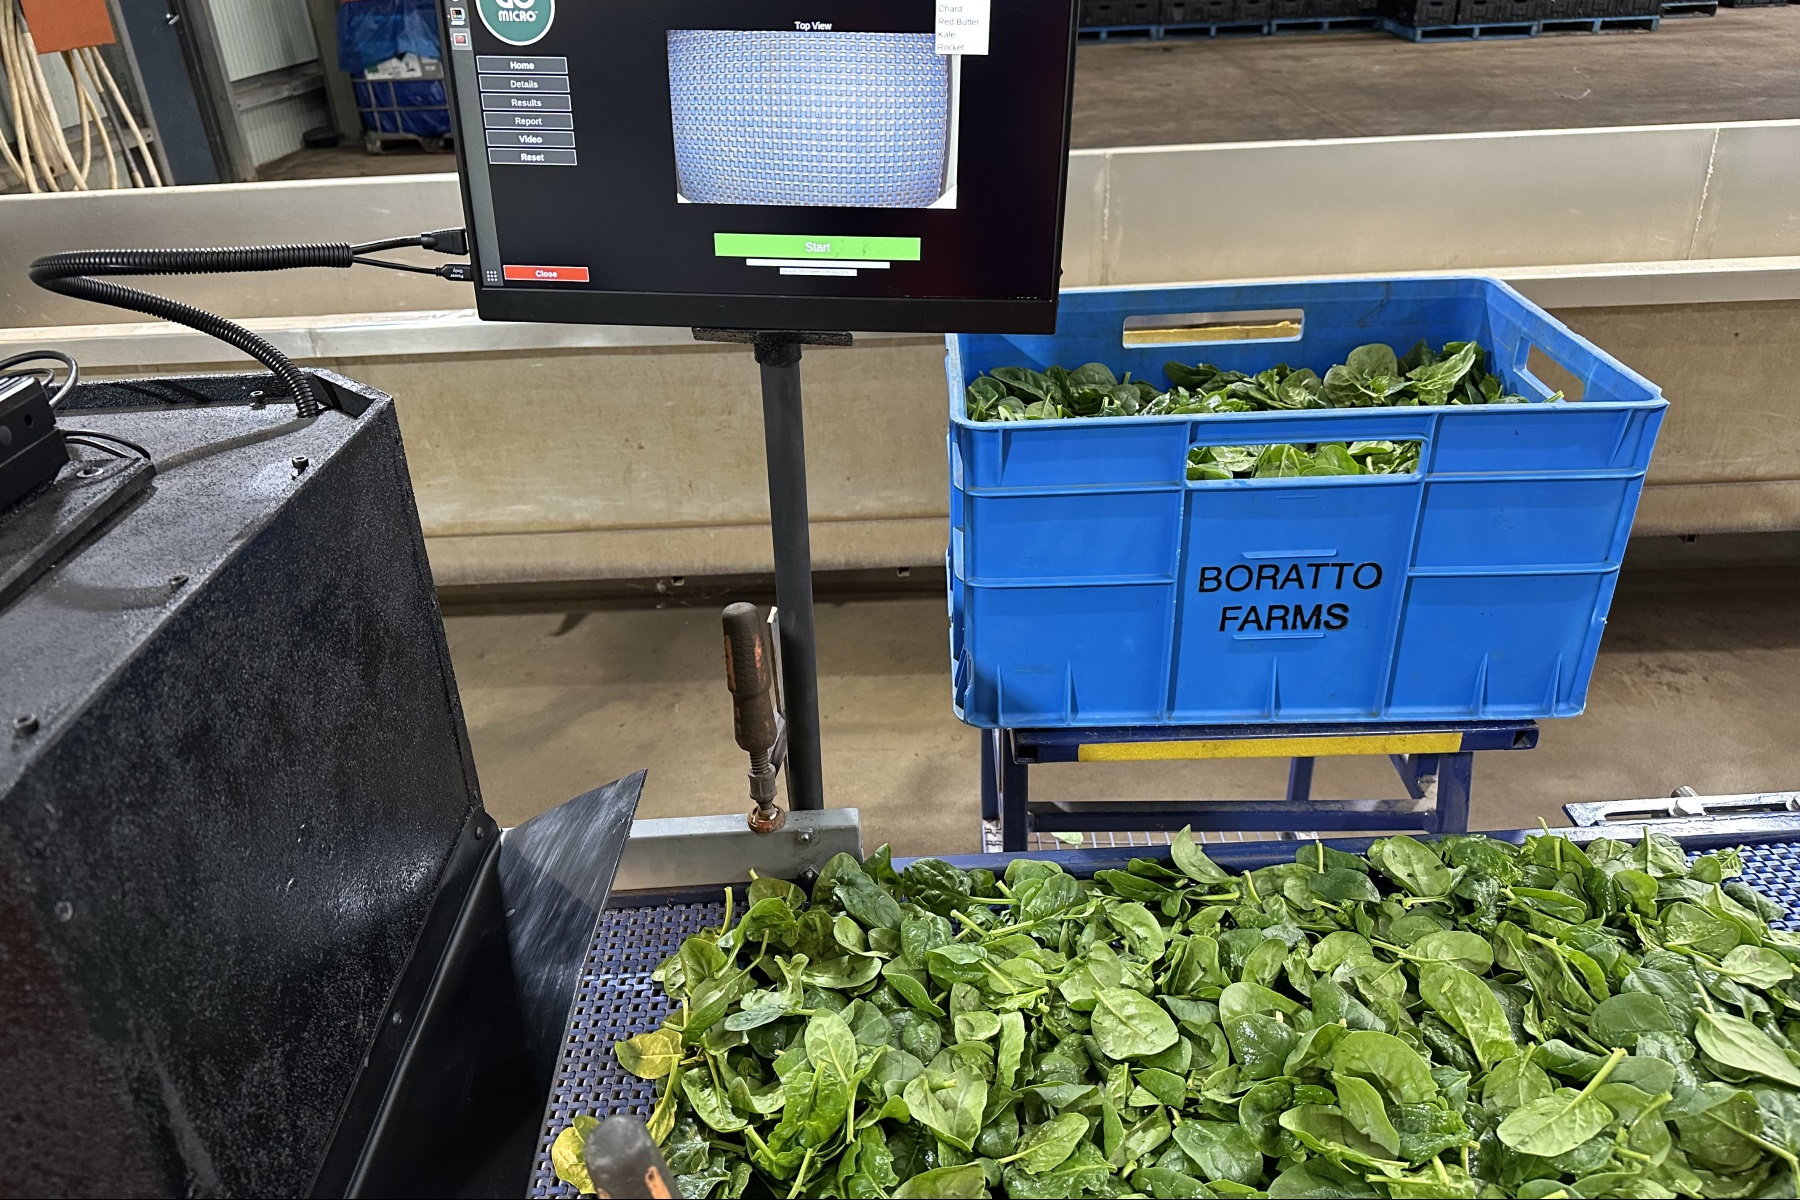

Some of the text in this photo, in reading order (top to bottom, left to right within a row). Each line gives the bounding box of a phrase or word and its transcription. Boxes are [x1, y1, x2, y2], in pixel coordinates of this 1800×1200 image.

[938, 4, 963, 13] Chard
[794, 20, 832, 31] Top View
[938, 17, 980, 26] Red Butter
[937, 30, 956, 39] Kale
[937, 43, 965, 51] Rocket
[510, 61, 534, 70] Home
[510, 80, 539, 89] Details
[511, 98, 542, 107] Results
[515, 117, 542, 127] Report
[519, 135, 543, 143] Video
[520, 153, 544, 161] Reset
[805, 242, 831, 252] Start
[535, 270, 557, 278] Close
[1198, 562, 1383, 593] BORATTO
[1219, 603, 1350, 633] FARMS
